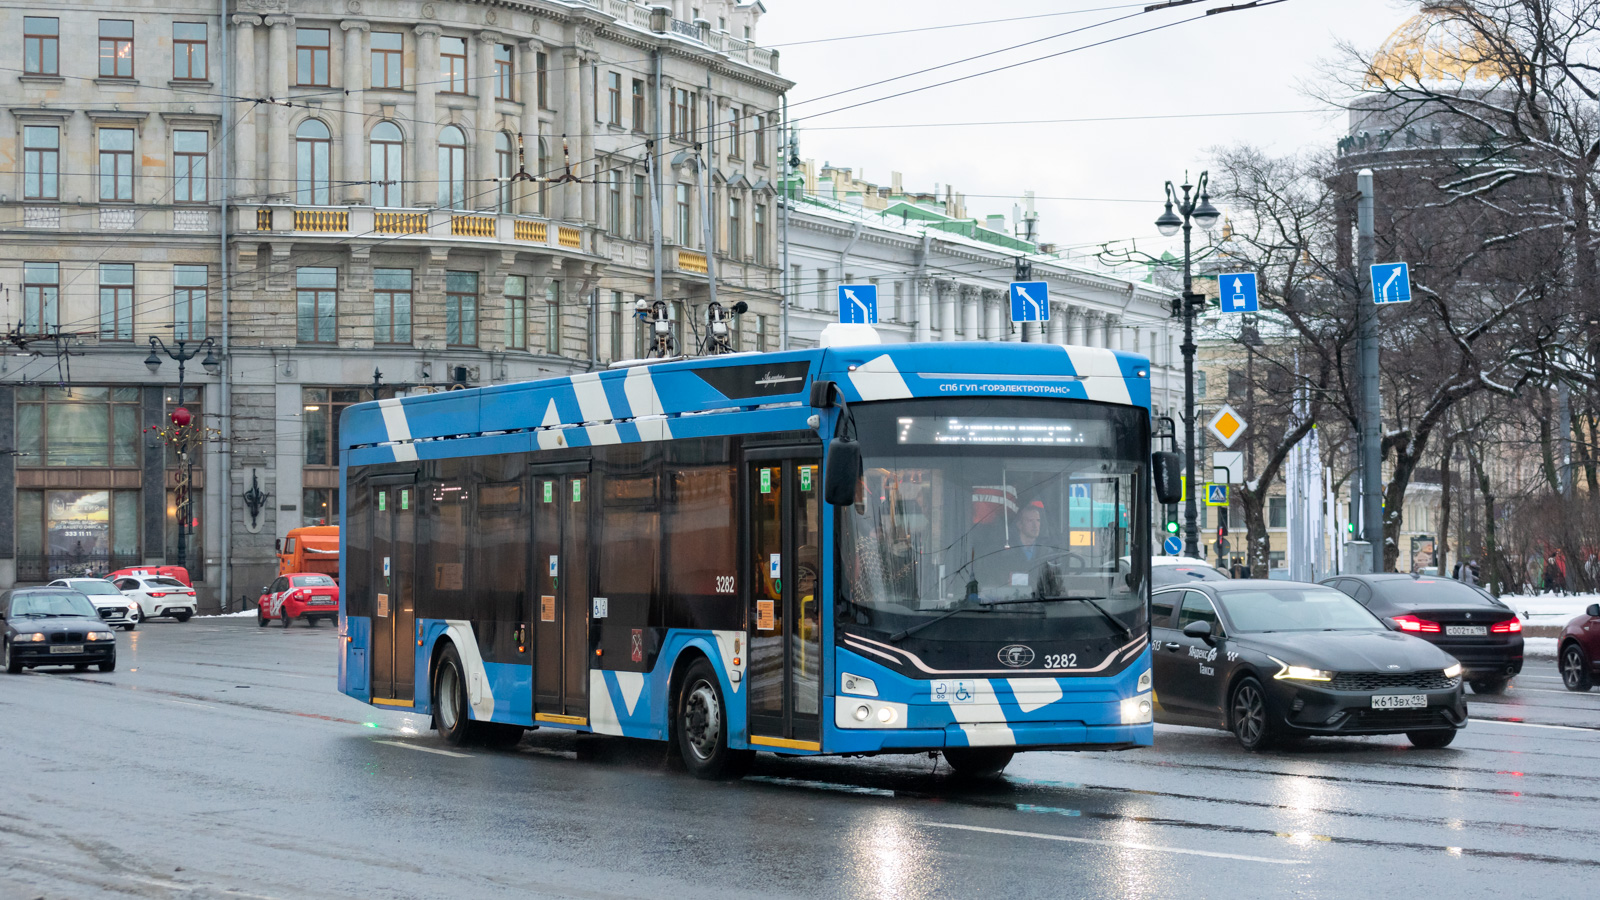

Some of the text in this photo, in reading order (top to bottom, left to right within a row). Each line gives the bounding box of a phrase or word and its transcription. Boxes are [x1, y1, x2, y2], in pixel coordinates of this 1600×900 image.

[939, 383, 1070, 394] СПб ГУП «ГОРЭЛЕКТРОТРАНС»
[898, 418, 913, 442] 7
[1079, 534, 1085, 543] 7
[715, 575, 735, 593] 3282
[1043, 653, 1078, 669] 3282
[1198, 662, 1214, 676] Такси
